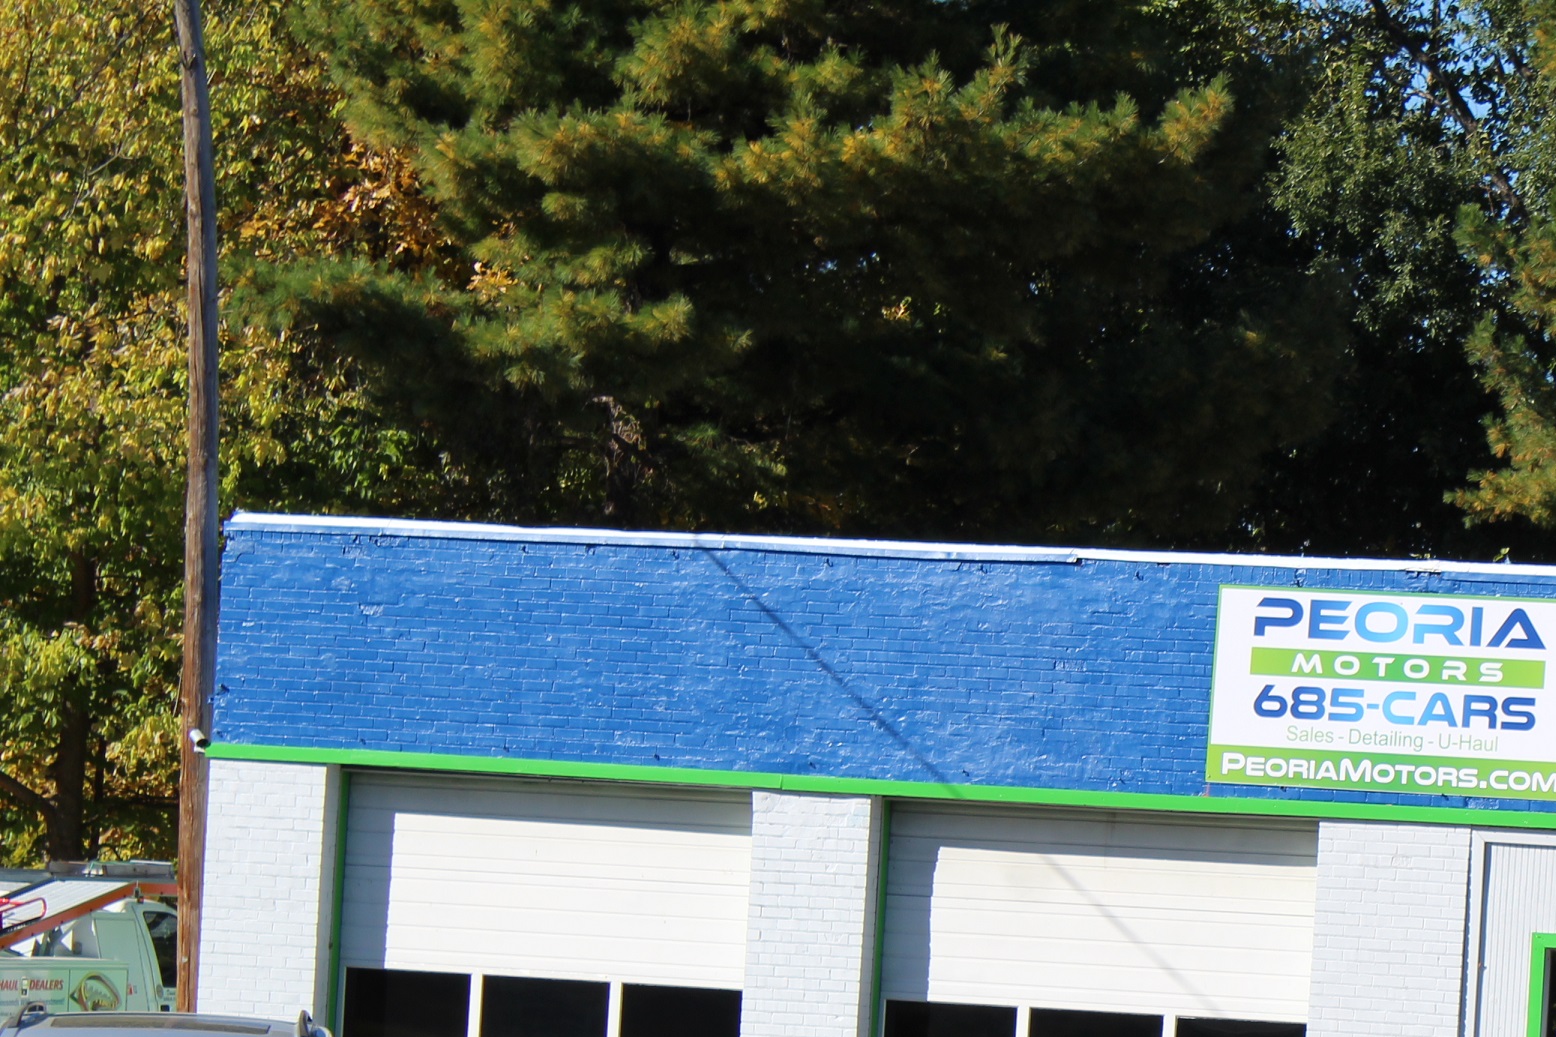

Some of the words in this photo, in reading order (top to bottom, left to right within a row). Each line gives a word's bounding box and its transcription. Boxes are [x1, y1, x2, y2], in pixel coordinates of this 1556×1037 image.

[1253, 597, 1547, 650] PEORIA
[1291, 653, 1504, 683] MOTORS
[1253, 684, 1536, 731] 685-CARS
[1286, 725, 1334, 744] Sales
[1348, 728, 1423, 753] Detailing
[1438, 732, 1499, 752] U-Haul
[29, 979, 64, 991] DEALERS
